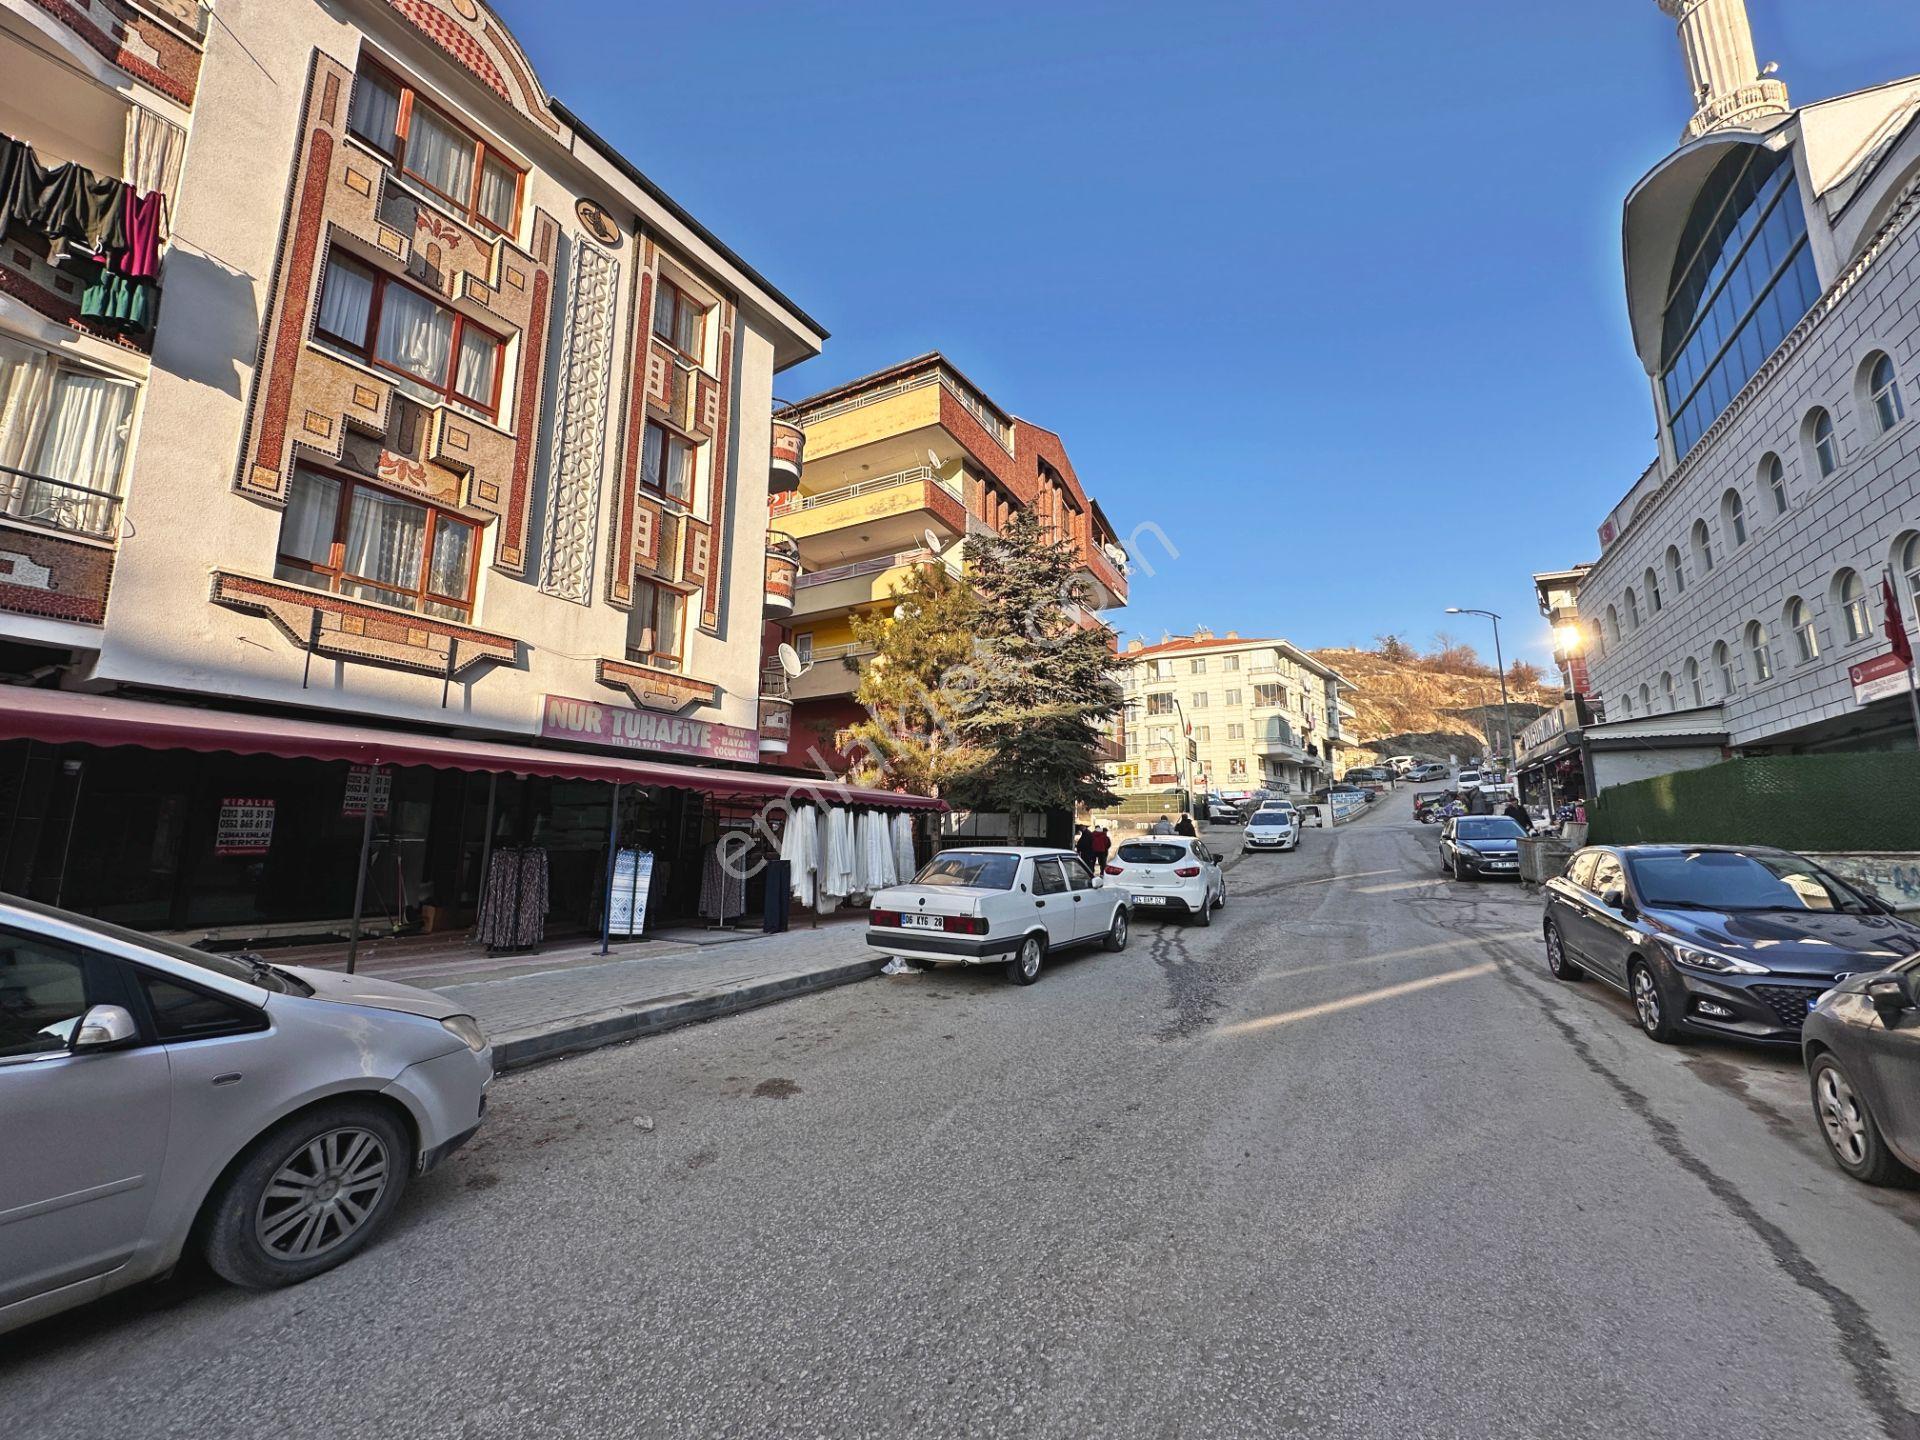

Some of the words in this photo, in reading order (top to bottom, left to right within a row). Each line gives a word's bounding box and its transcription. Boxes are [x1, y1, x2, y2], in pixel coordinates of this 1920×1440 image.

[550, 700, 602, 733] NUR
[727, 727, 745, 738] BAY
[721, 736, 751, 749] BAYAN
[221, 809, 238, 818] 0312
[255, 810, 264, 819] 51
[218, 839, 269, 847] MERKEZ
[905, 915, 913, 925] 06
[934, 918, 943, 927] 28
